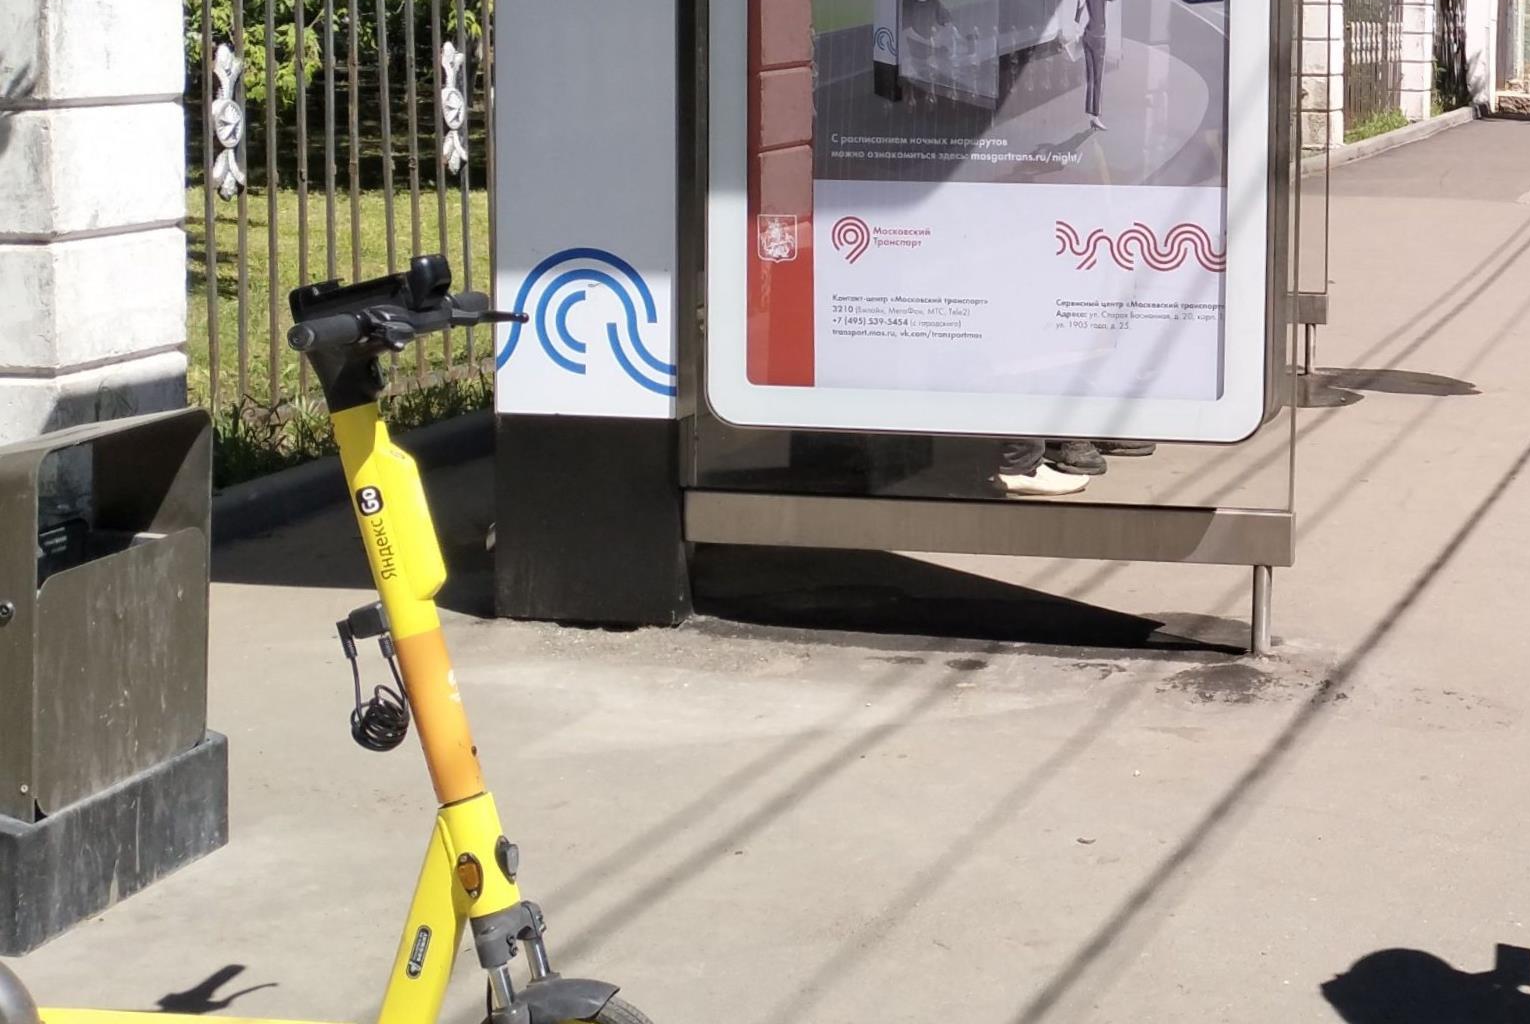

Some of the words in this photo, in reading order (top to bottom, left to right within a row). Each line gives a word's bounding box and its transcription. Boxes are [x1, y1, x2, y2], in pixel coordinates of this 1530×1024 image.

[831, 133, 839, 143] С
[841, 135, 908, 147] расписанием
[910, 137, 948, 146] ночных
[950, 137, 1008, 149] маршрутов
[831, 150, 865, 159] можно
[867, 150, 936, 160] ознакомиться
[970, 152, 1084, 165] mosgortrans.ru/night/
[873, 226, 932, 237] Московский
[873, 237, 922, 248] Транспорт
[832, 294, 889, 304] Контакт-центр
[1055, 298, 1100, 309] Сервисный
[1101, 300, 1124, 310] центр
[832, 305, 854, 313] 3210
[832, 316, 842, 325] +7
[844, 316, 866, 326] (495)
[868, 317, 909, 327] 539-5454
[1068, 321, 1088, 329] 1905
[361, 487, 381, 514] Go
[371, 518, 398, 580] Яндекс
